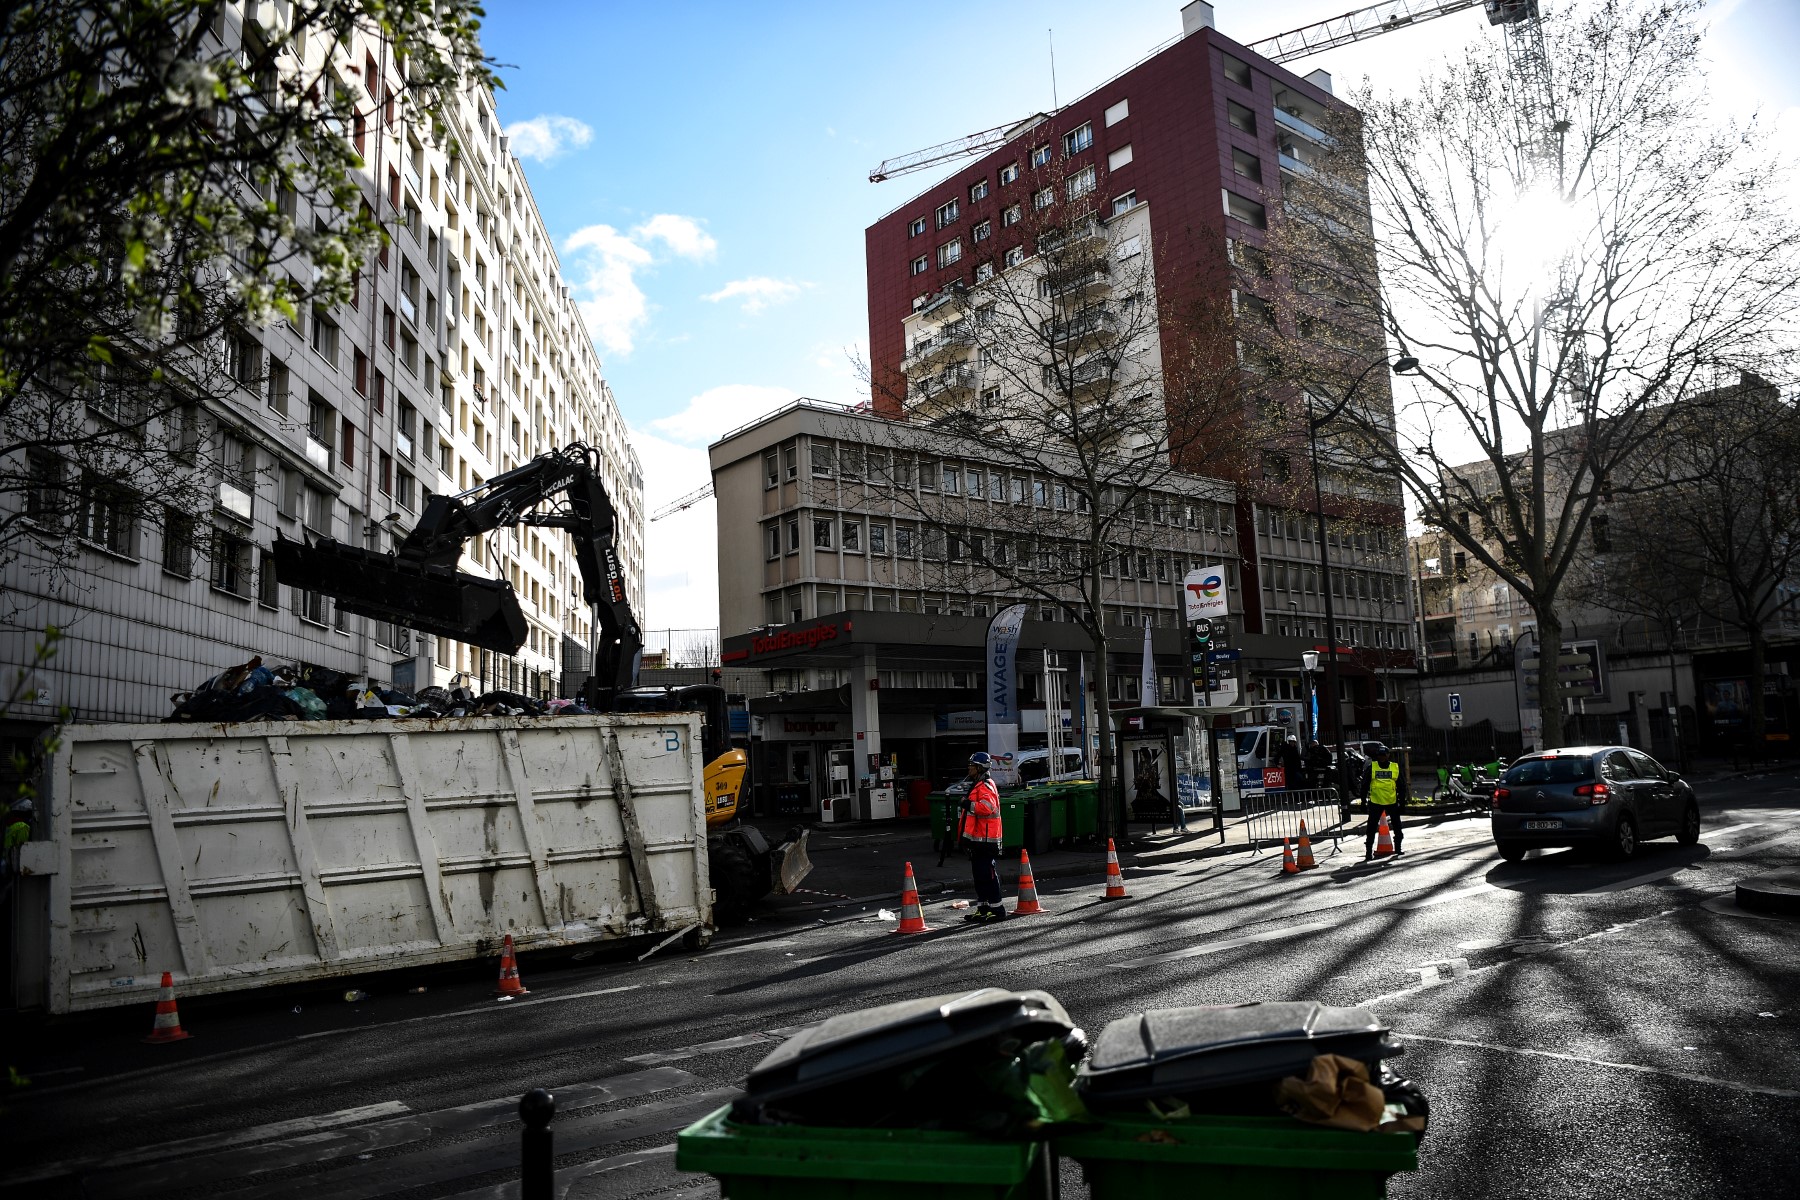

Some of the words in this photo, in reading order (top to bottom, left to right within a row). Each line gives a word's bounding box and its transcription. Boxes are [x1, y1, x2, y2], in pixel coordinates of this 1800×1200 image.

[605, 549, 623, 602] LUSOLOC
[752, 622, 838, 655] TotalEnergies
[1196, 623, 1209, 632] BUS
[994, 640, 1007, 718] LAVAGE
[1452, 699, 1457, 710] P
[784, 717, 838, 735] bonjour
